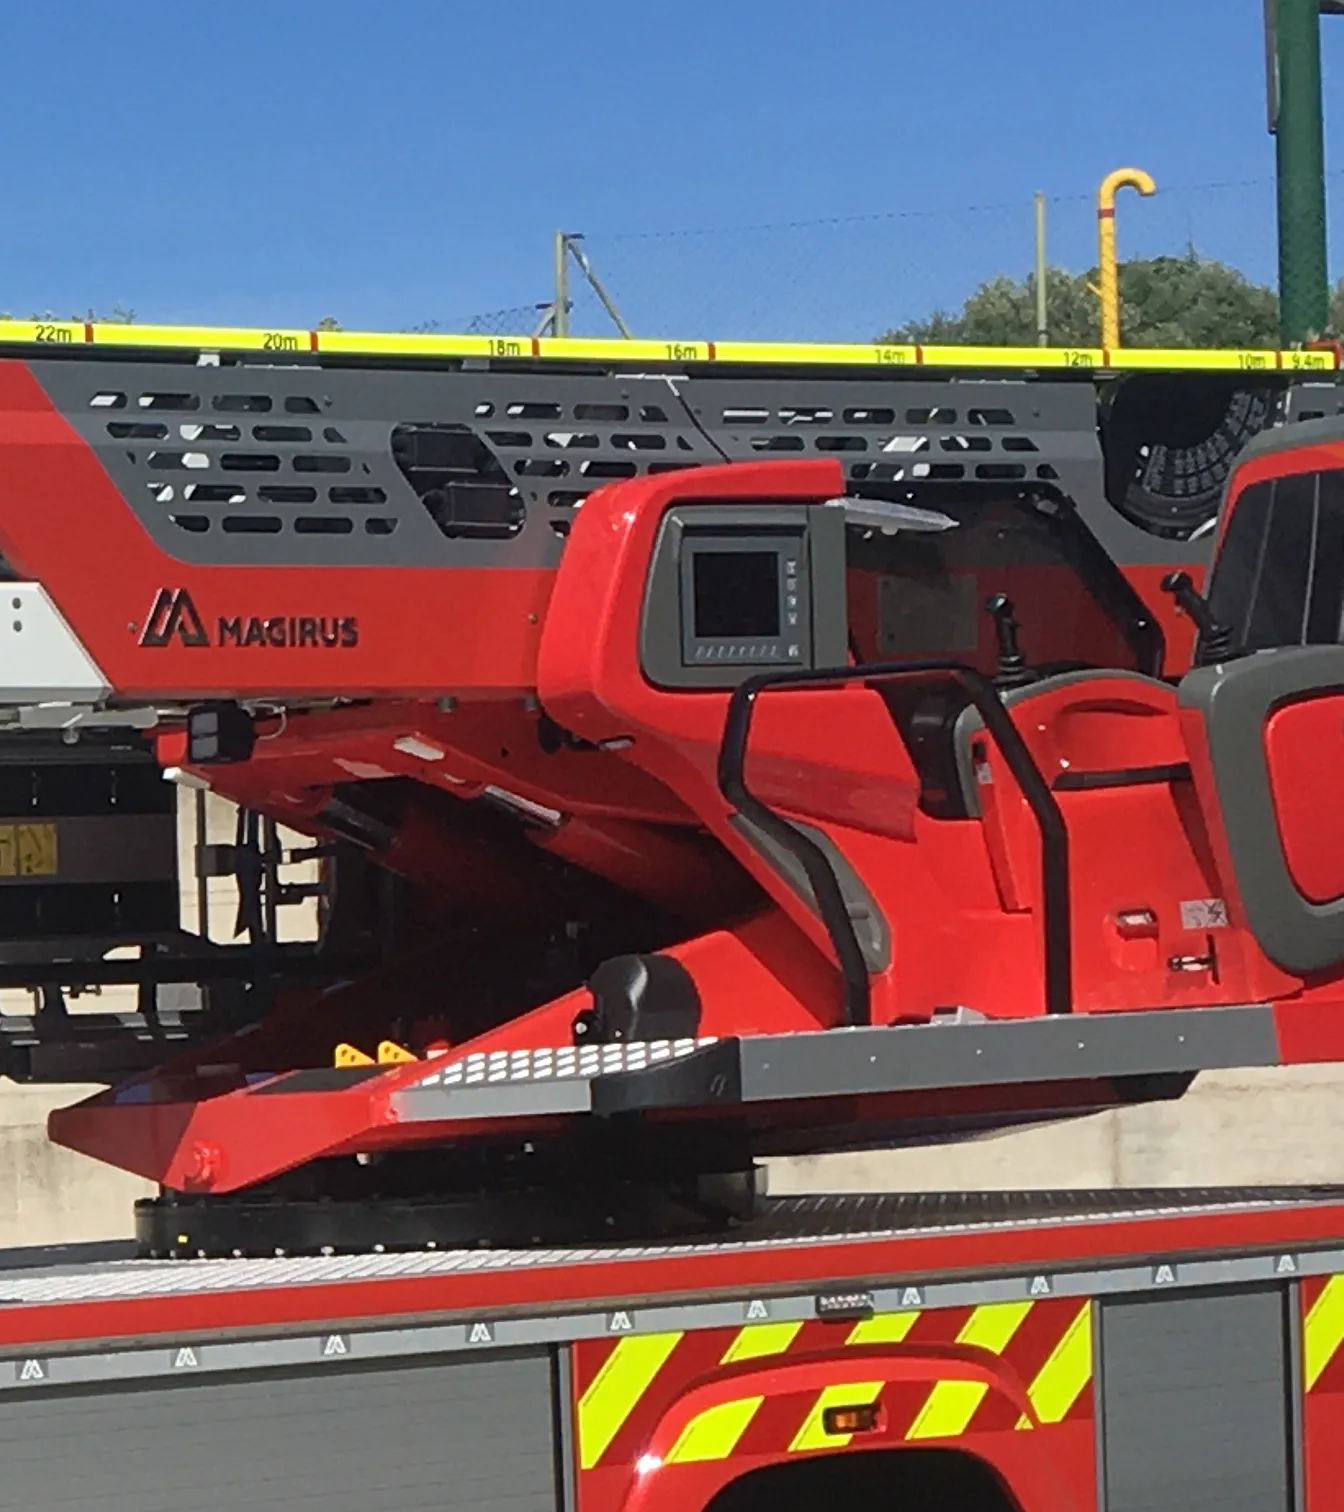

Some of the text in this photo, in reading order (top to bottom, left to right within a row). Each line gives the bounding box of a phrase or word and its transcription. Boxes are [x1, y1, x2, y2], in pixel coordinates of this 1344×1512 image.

[35, 324, 72, 342] 22m
[263, 332, 298, 351] 20m
[488, 339, 520, 356] 18m
[665, 343, 697, 360] 16m
[874, 348, 906, 364] 14m
[1063, 350, 1093, 366] 12m
[1238, 353, 1266, 370] 10m
[218, 616, 358, 648] MAGIRUS
